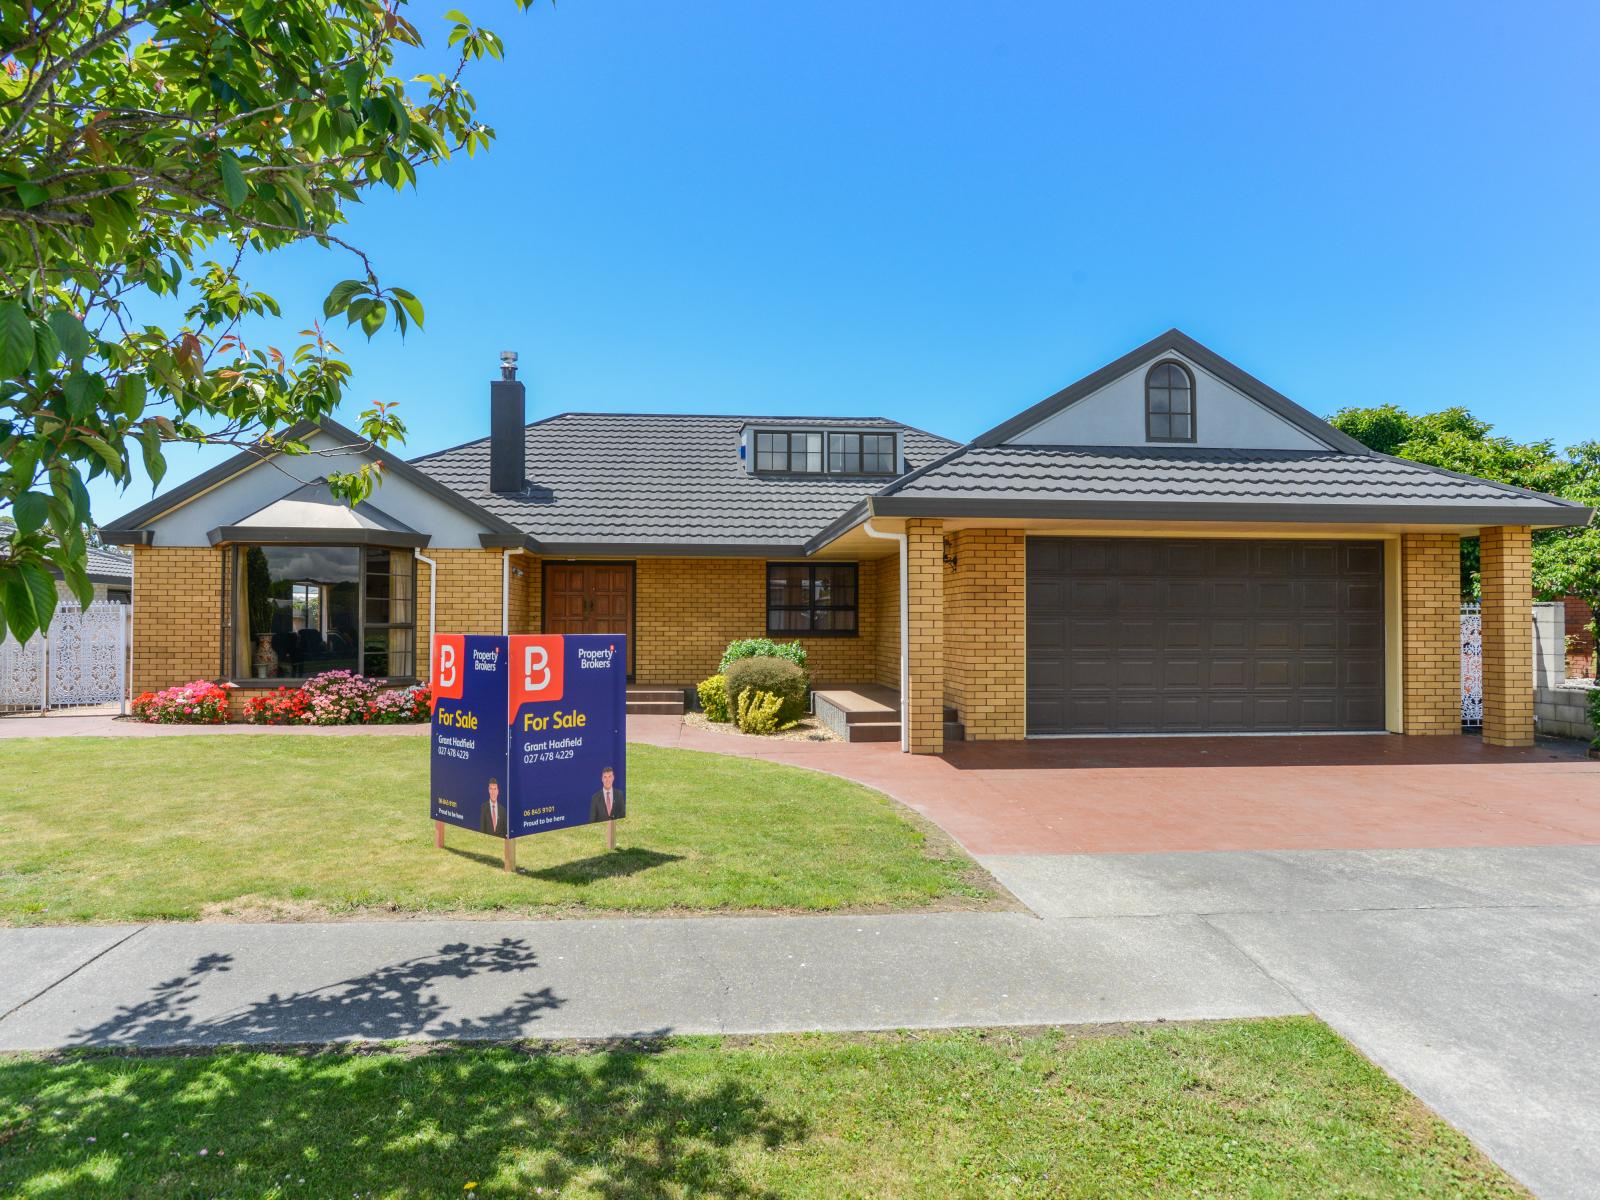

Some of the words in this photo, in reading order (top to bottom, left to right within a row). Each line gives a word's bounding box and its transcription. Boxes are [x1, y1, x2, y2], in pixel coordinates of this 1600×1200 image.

[473, 649, 498, 662] Property
[578, 648, 613, 660] Property
[475, 660, 496, 671] Brokers
[582, 659, 611, 669] Brokers
[439, 708, 454, 726] For
[456, 710, 478, 729] Sale
[524, 713, 549, 732] For
[553, 710, 586, 729] Sale
[438, 735, 452, 745] Grant
[452, 737, 475, 749] Hadfield
[523, 741, 547, 752] Grant
[548, 737, 582, 749] Hadfield
[523, 754, 538, 764] 027
[539, 752, 554, 762] 478
[555, 749, 574, 760] 4229
[523, 819, 539, 828] Proud
